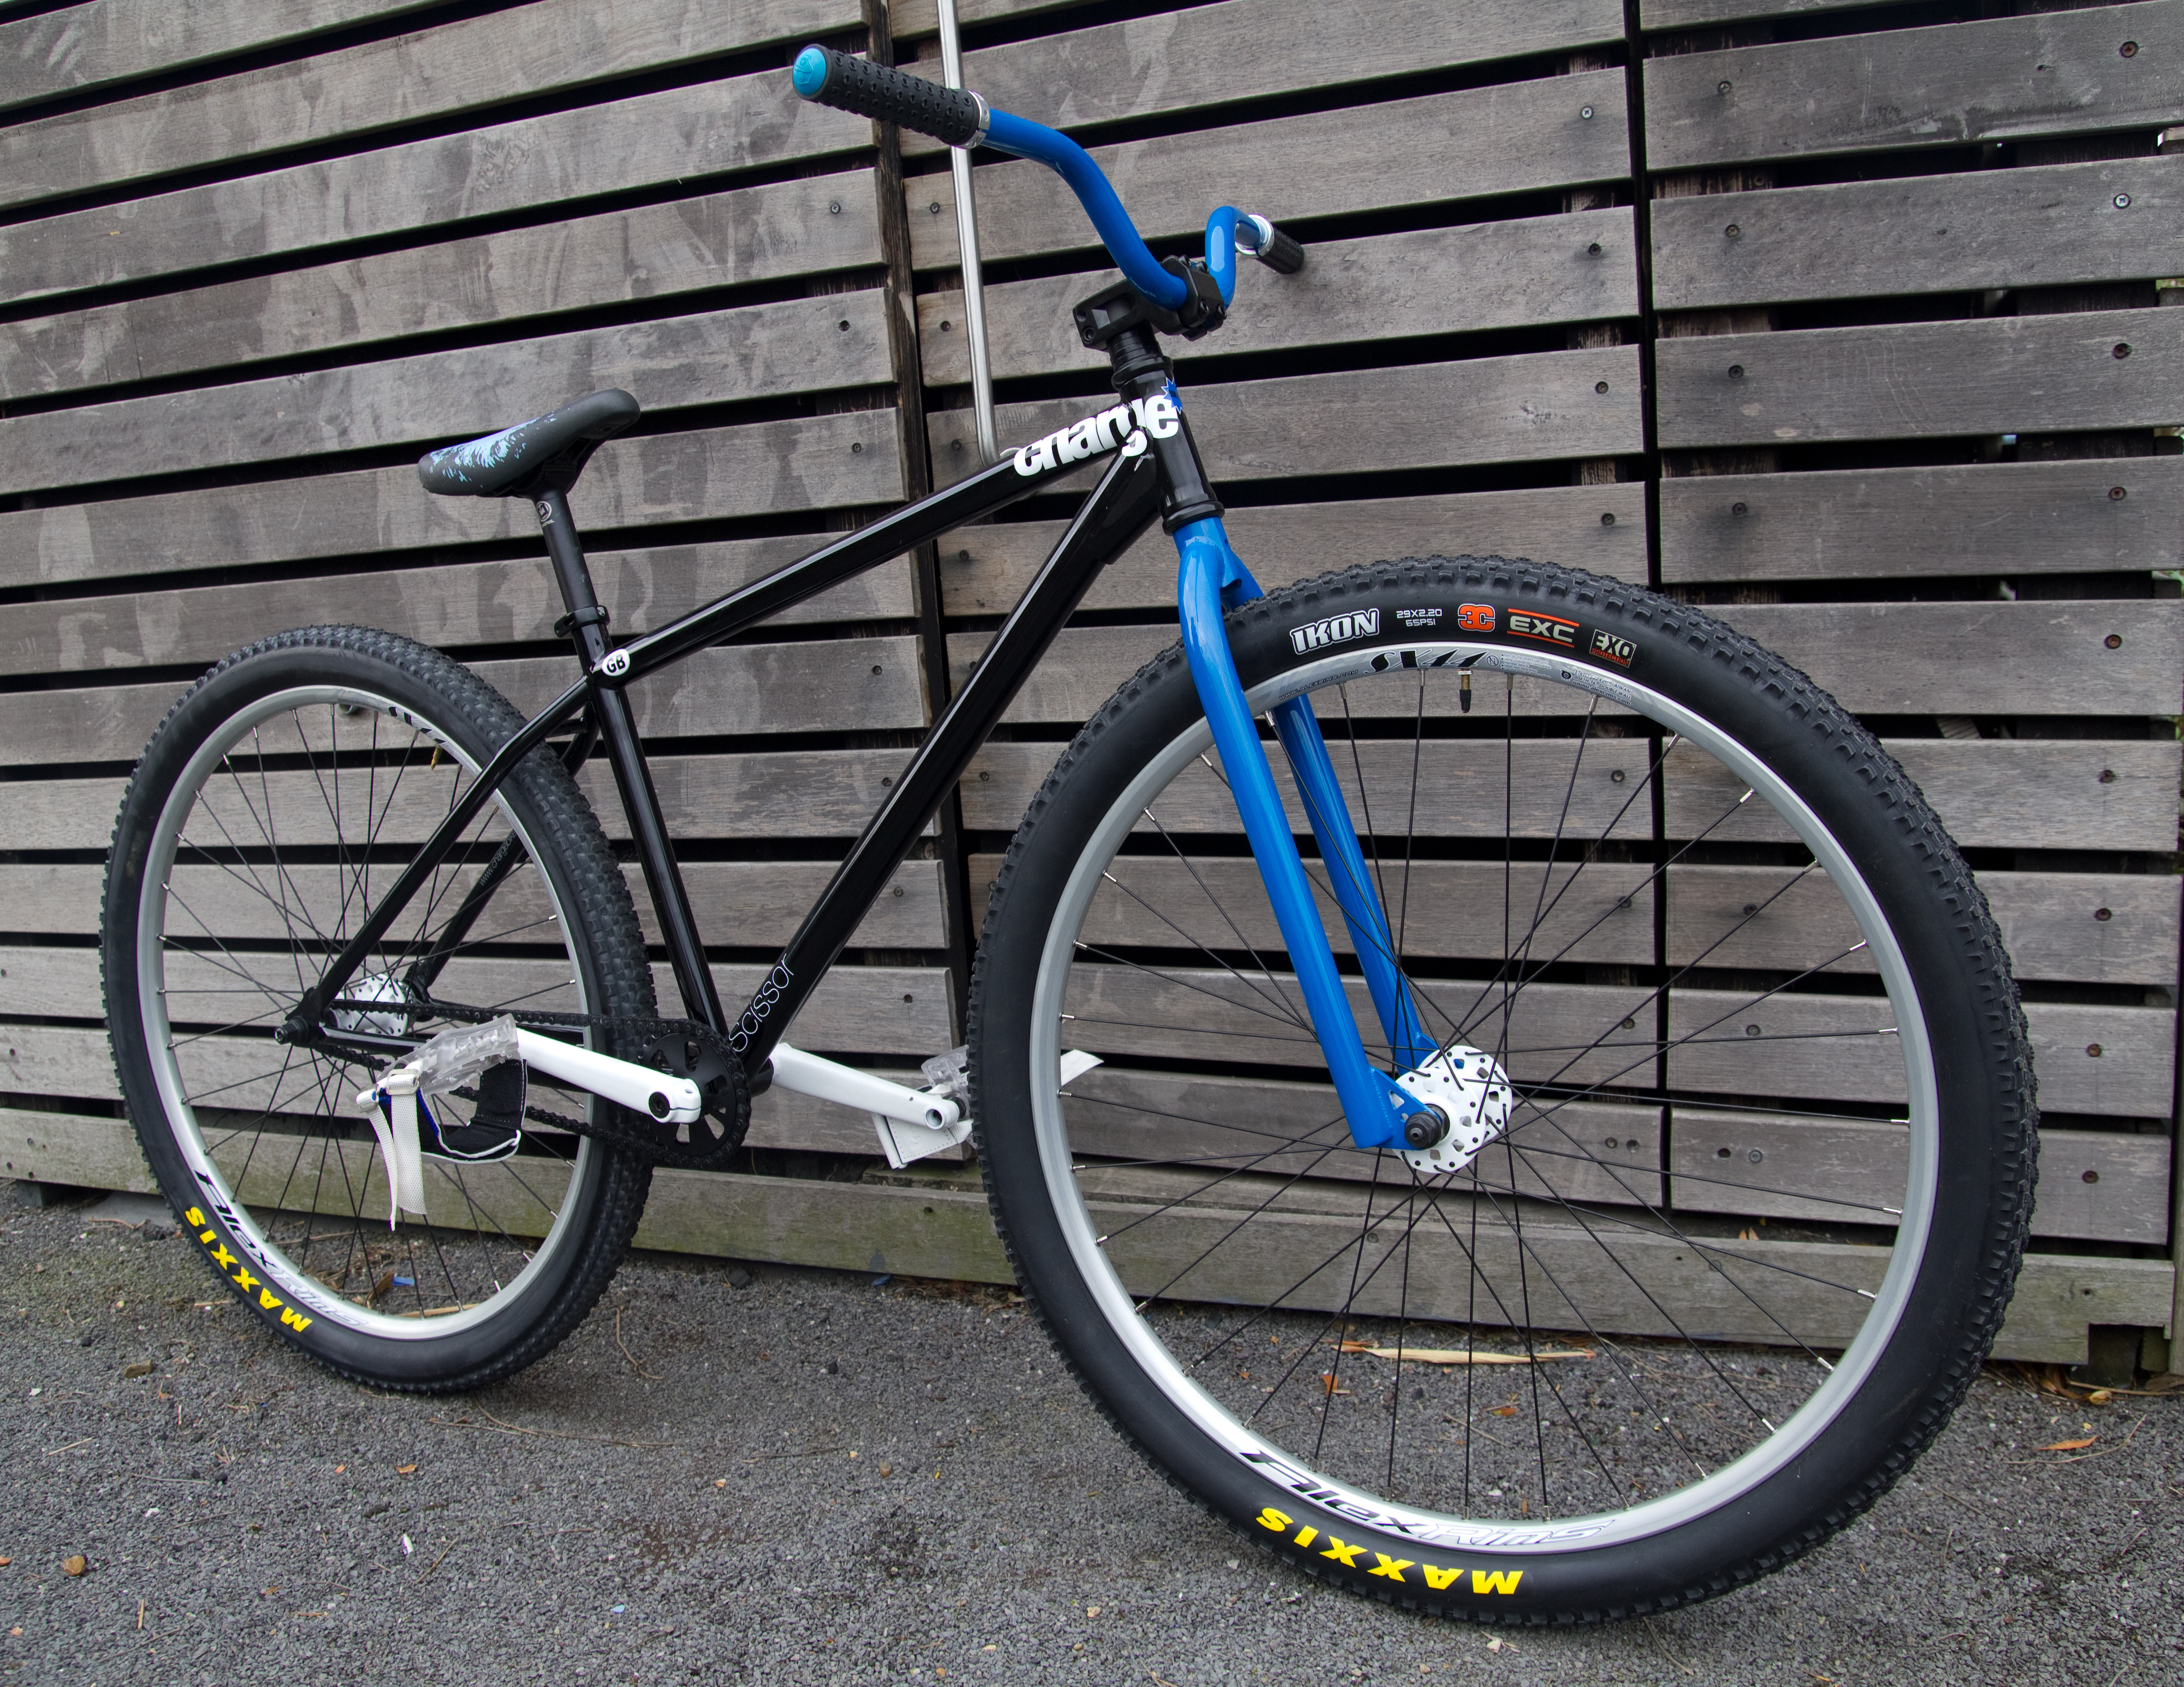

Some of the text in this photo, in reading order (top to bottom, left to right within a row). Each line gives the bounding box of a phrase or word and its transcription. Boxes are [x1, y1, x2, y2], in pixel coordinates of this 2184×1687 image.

[1396, 609, 1442, 619] 29X2.20
[1405, 618, 1436, 627] 65PSI
[1290, 608, 1380, 655] IKON
[1510, 616, 1575, 643] EXC
[1593, 633, 1634, 660] EXO
[607, 654, 626, 673] GB
[1599, 684, 1618, 694] DOUBLE
[1619, 690, 1632, 700] WALL
[1611, 683, 1632, 694] TAIWAN
[728, 953, 794, 1052] scissor
[185, 1207, 313, 1333] MAXXIS
[1256, 1507, 1524, 1595] MAXXIS
